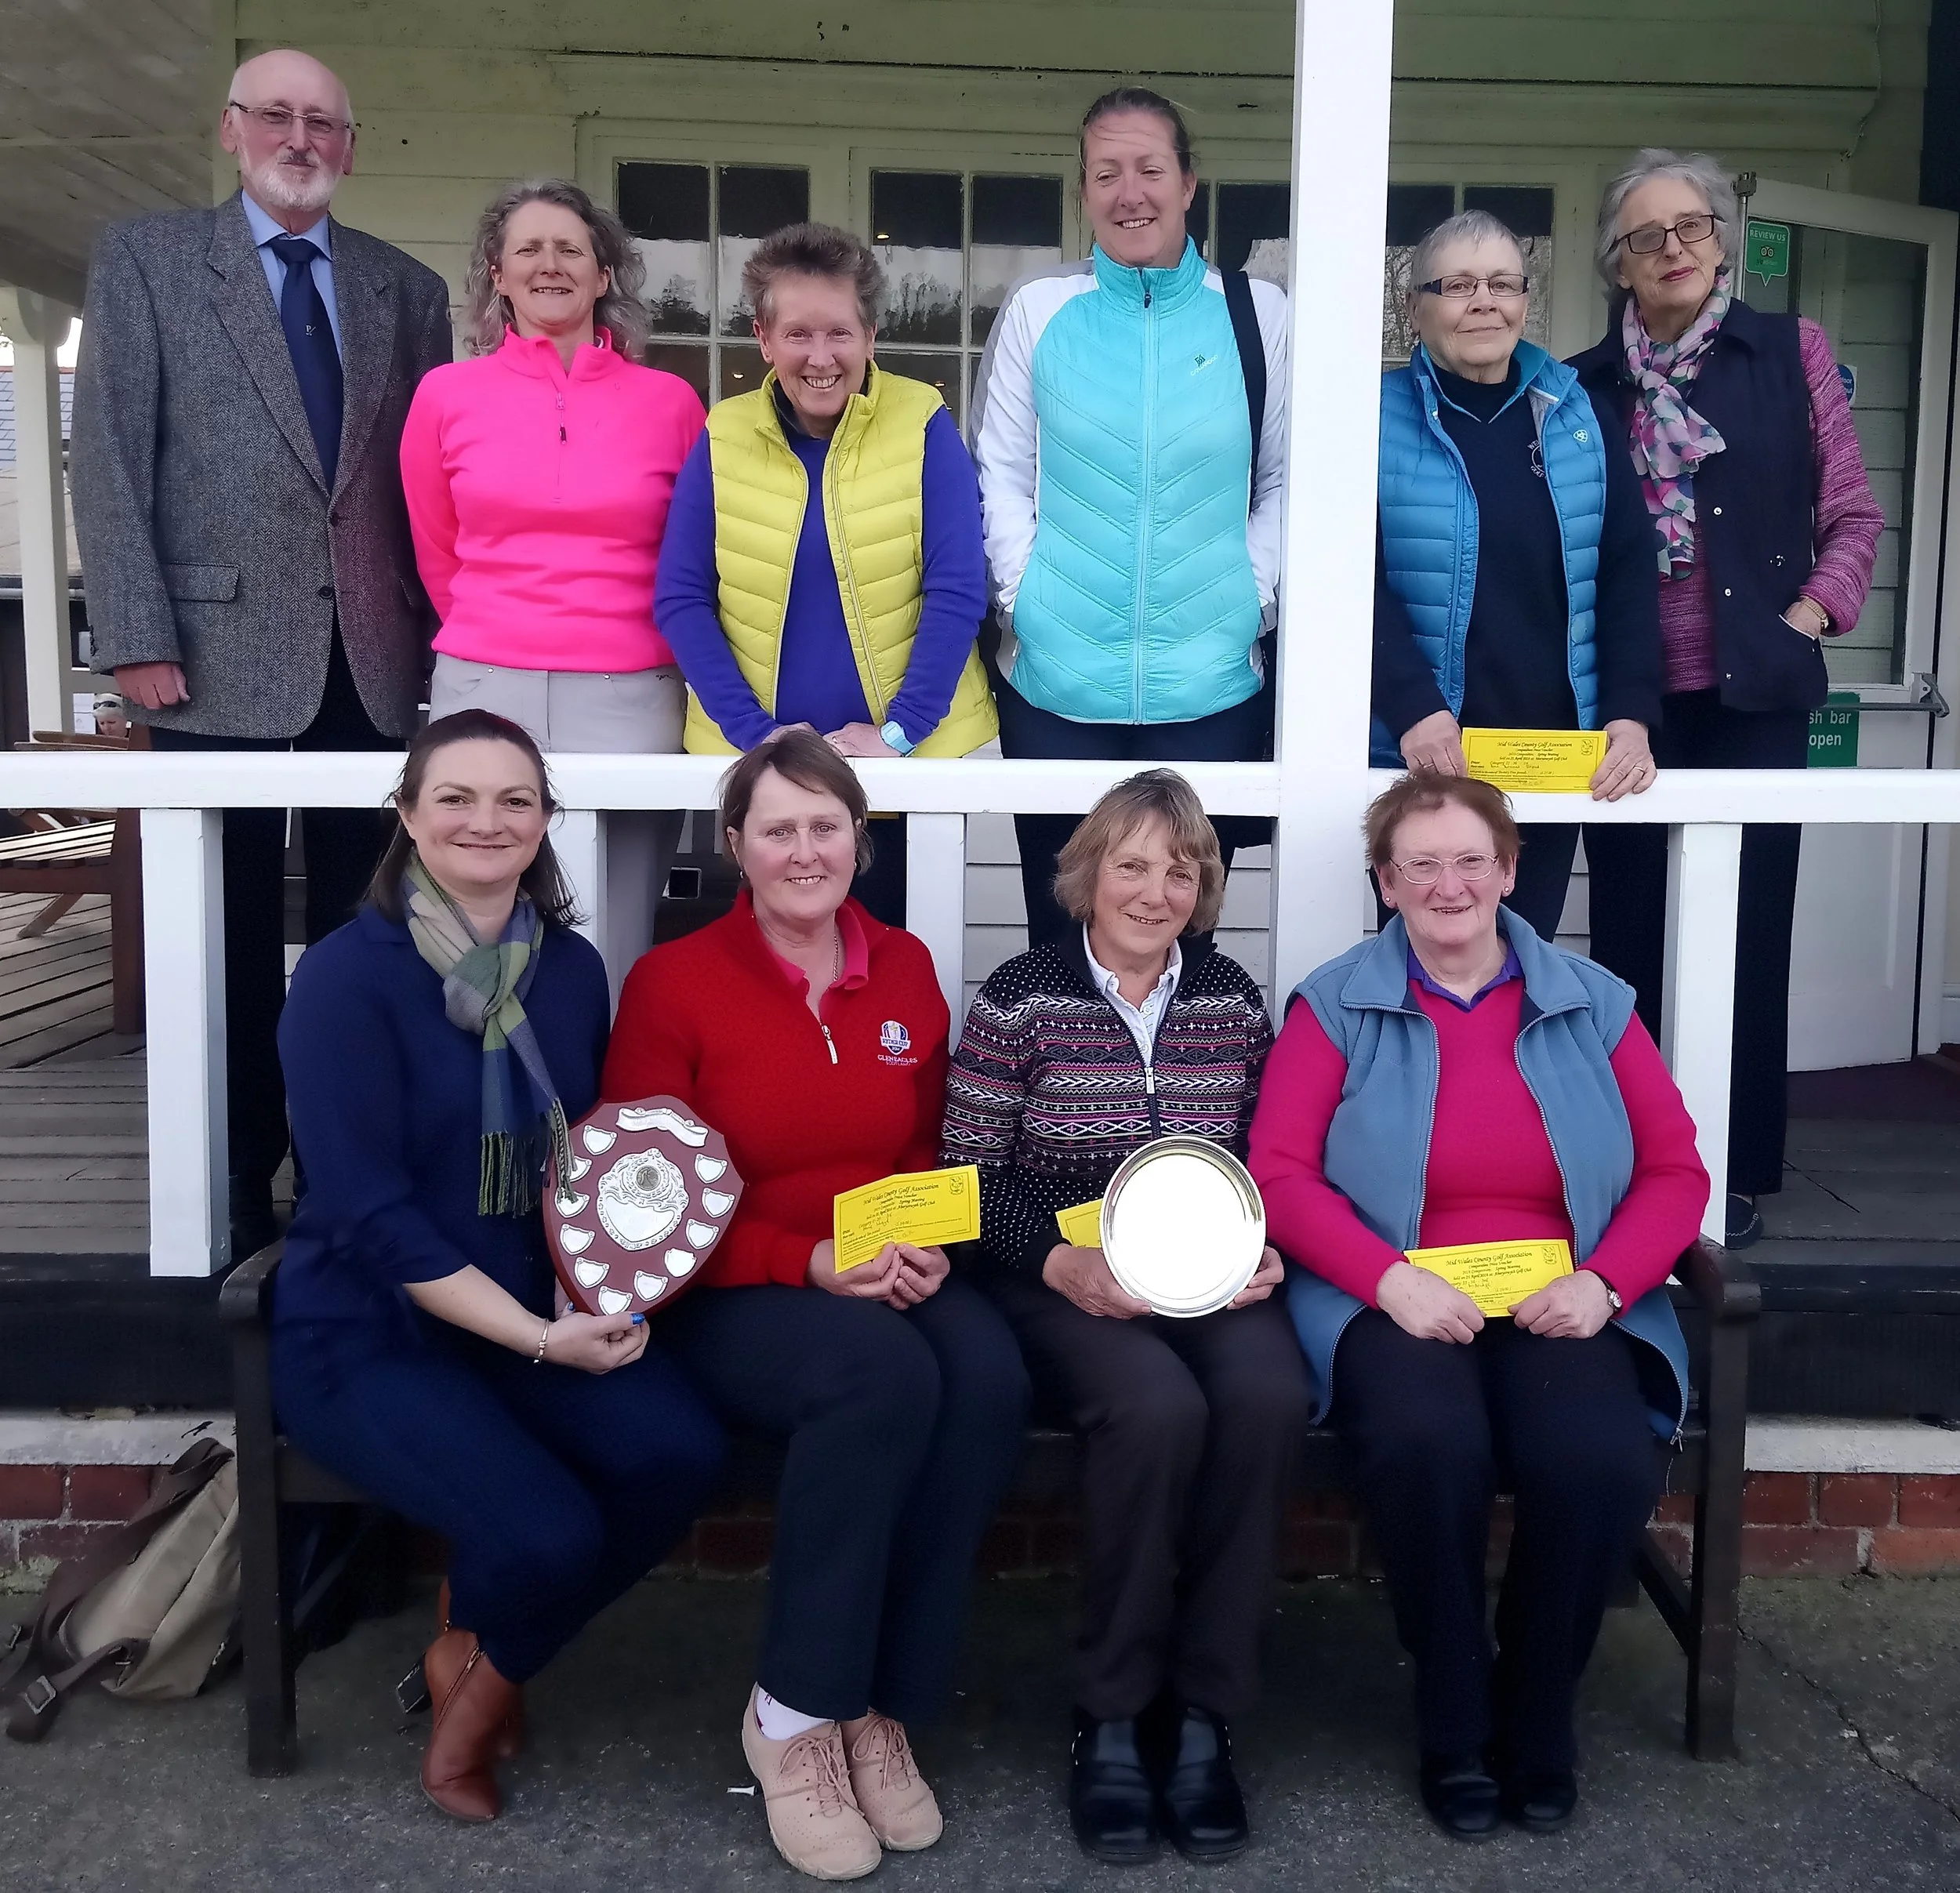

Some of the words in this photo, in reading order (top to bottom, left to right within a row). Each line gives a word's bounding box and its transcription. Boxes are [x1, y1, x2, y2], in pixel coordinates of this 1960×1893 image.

[1749, 230, 1776, 239] REVIEW
[1809, 710, 1823, 724] sh
[1830, 710, 1852, 724] bar
[1809, 734, 1842, 749] open
[877, 1054, 918, 1063] GLENEAGLES
[898, 1186, 910, 1195] Golf
[1504, 1251, 1533, 1260] Association
